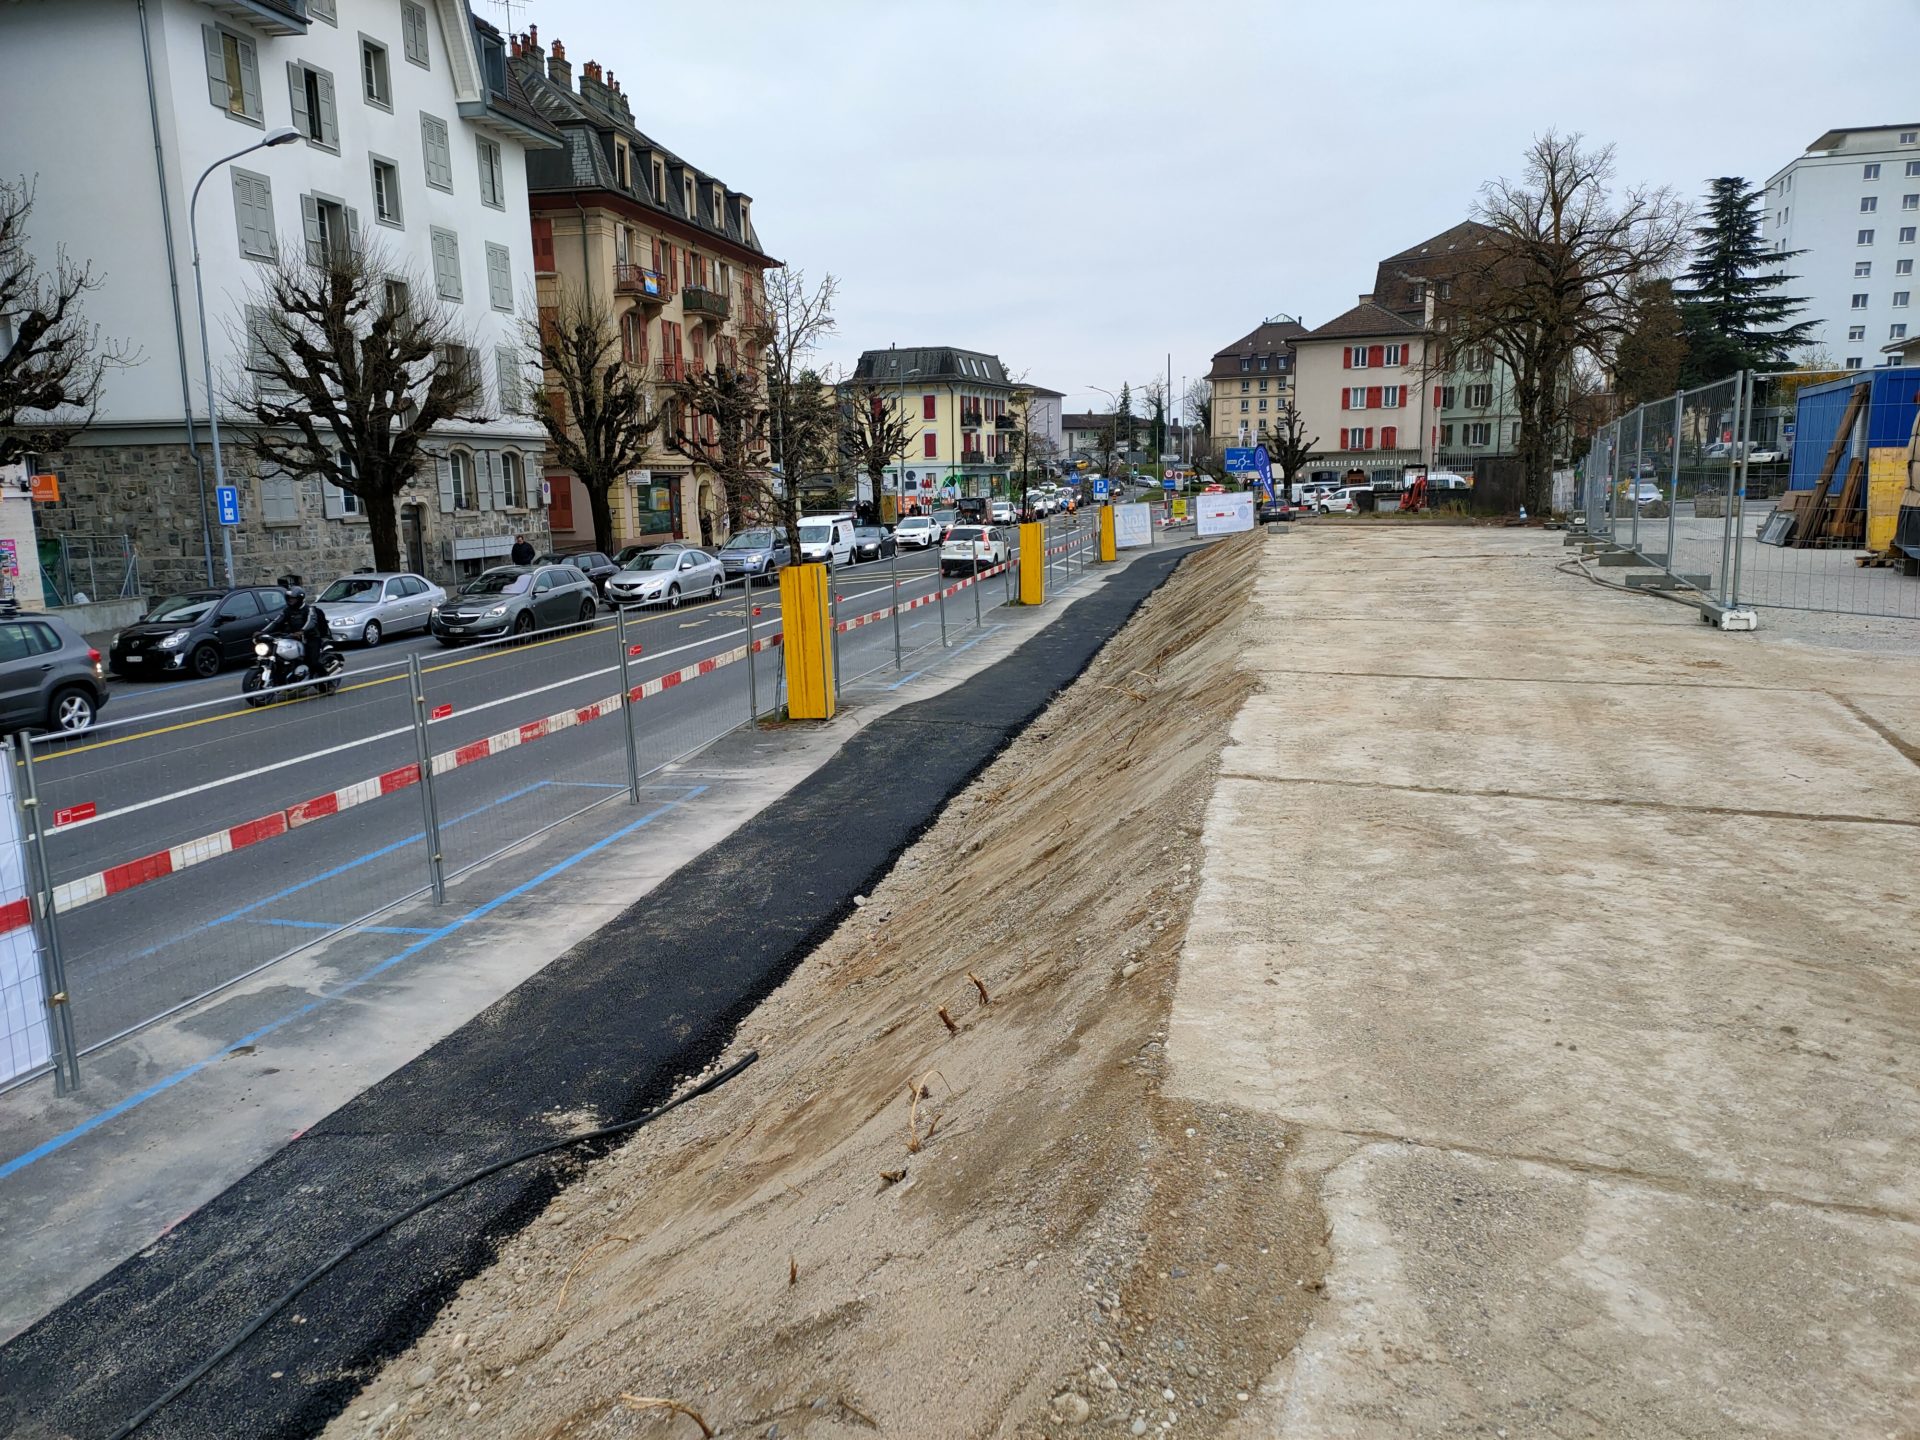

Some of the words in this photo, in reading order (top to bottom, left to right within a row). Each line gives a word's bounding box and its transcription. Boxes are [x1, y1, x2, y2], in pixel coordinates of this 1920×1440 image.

[1366, 459, 1408, 467] ABATTOIRS
[1096, 481, 1104, 492] P
[223, 490, 232, 507] P
